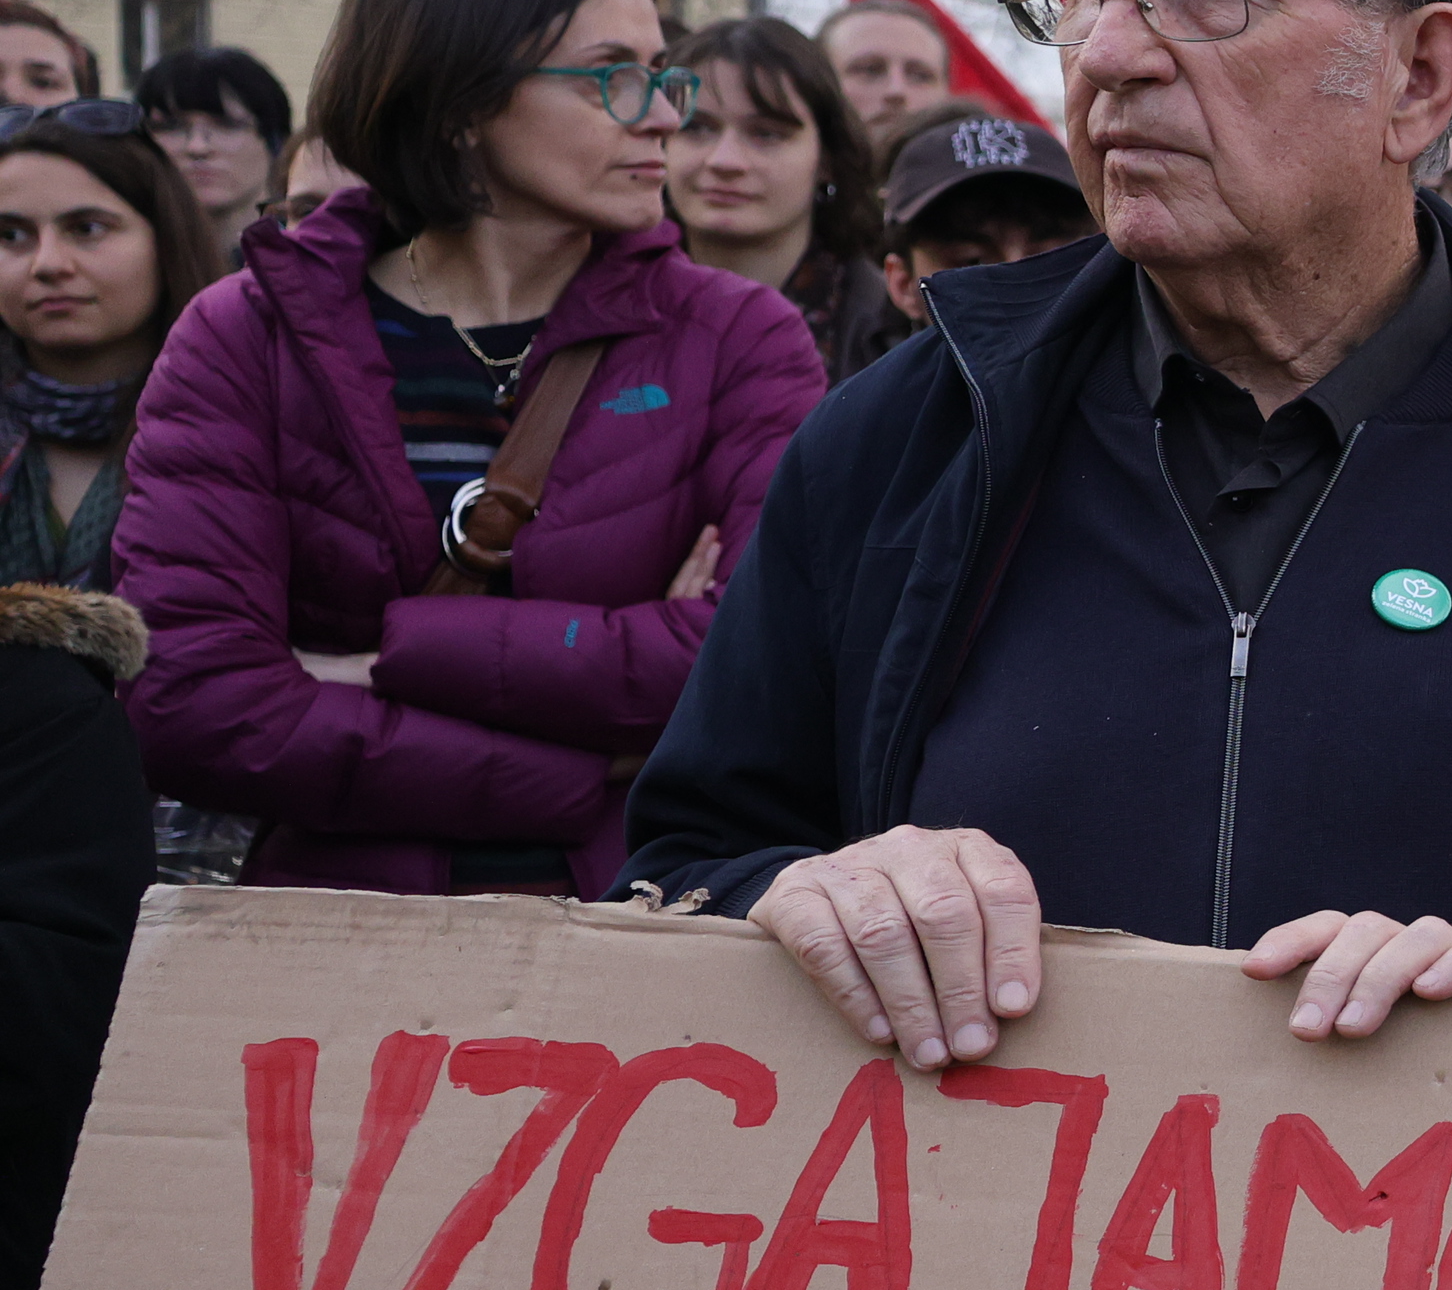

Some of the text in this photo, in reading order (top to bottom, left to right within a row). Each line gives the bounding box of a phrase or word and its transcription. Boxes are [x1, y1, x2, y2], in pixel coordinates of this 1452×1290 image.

[1381, 600, 1432, 624] zelena stranka
[1387, 591, 1434, 618] VESNA
